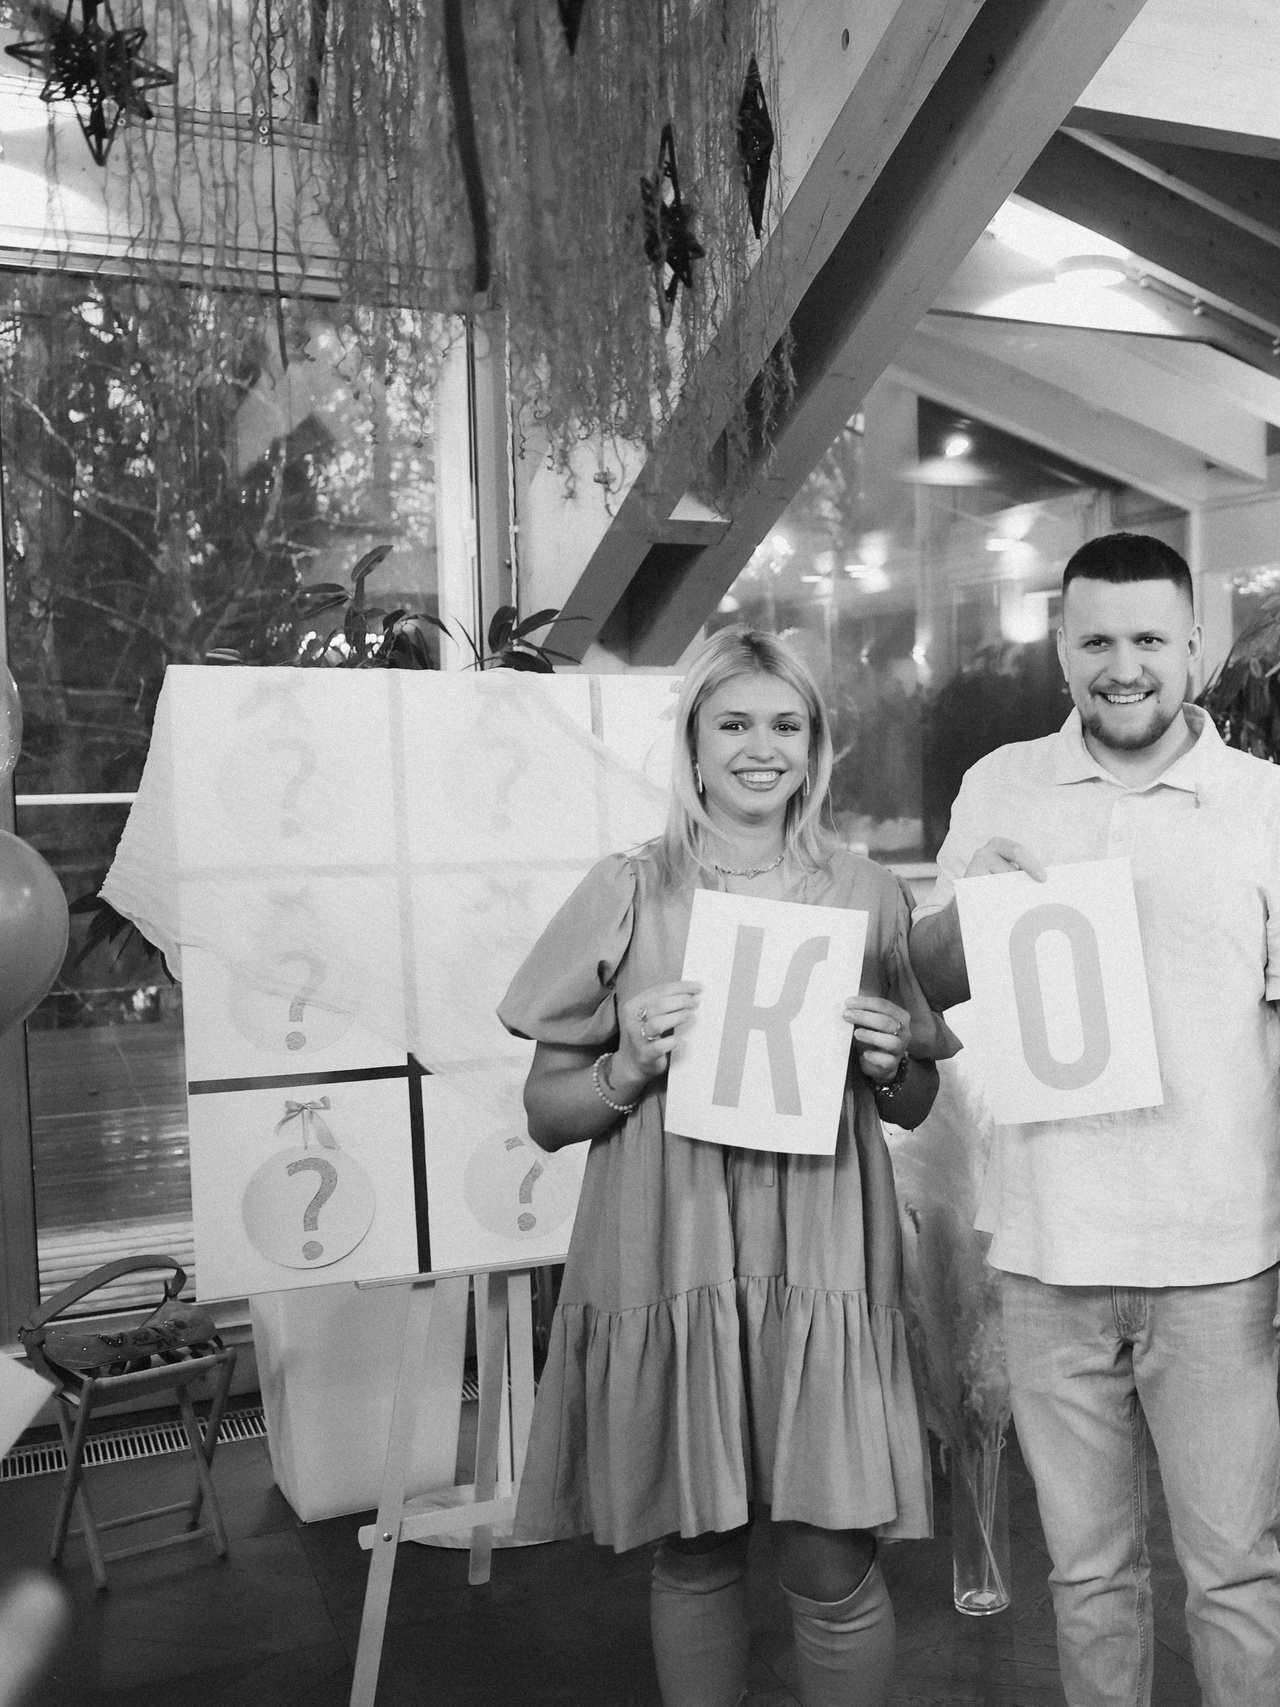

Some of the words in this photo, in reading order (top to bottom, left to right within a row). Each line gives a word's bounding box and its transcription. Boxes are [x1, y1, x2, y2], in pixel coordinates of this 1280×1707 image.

[277, 950, 326, 1052] ?
[286, 1156, 338, 1260] ?
[503, 1136, 546, 1233] ?
